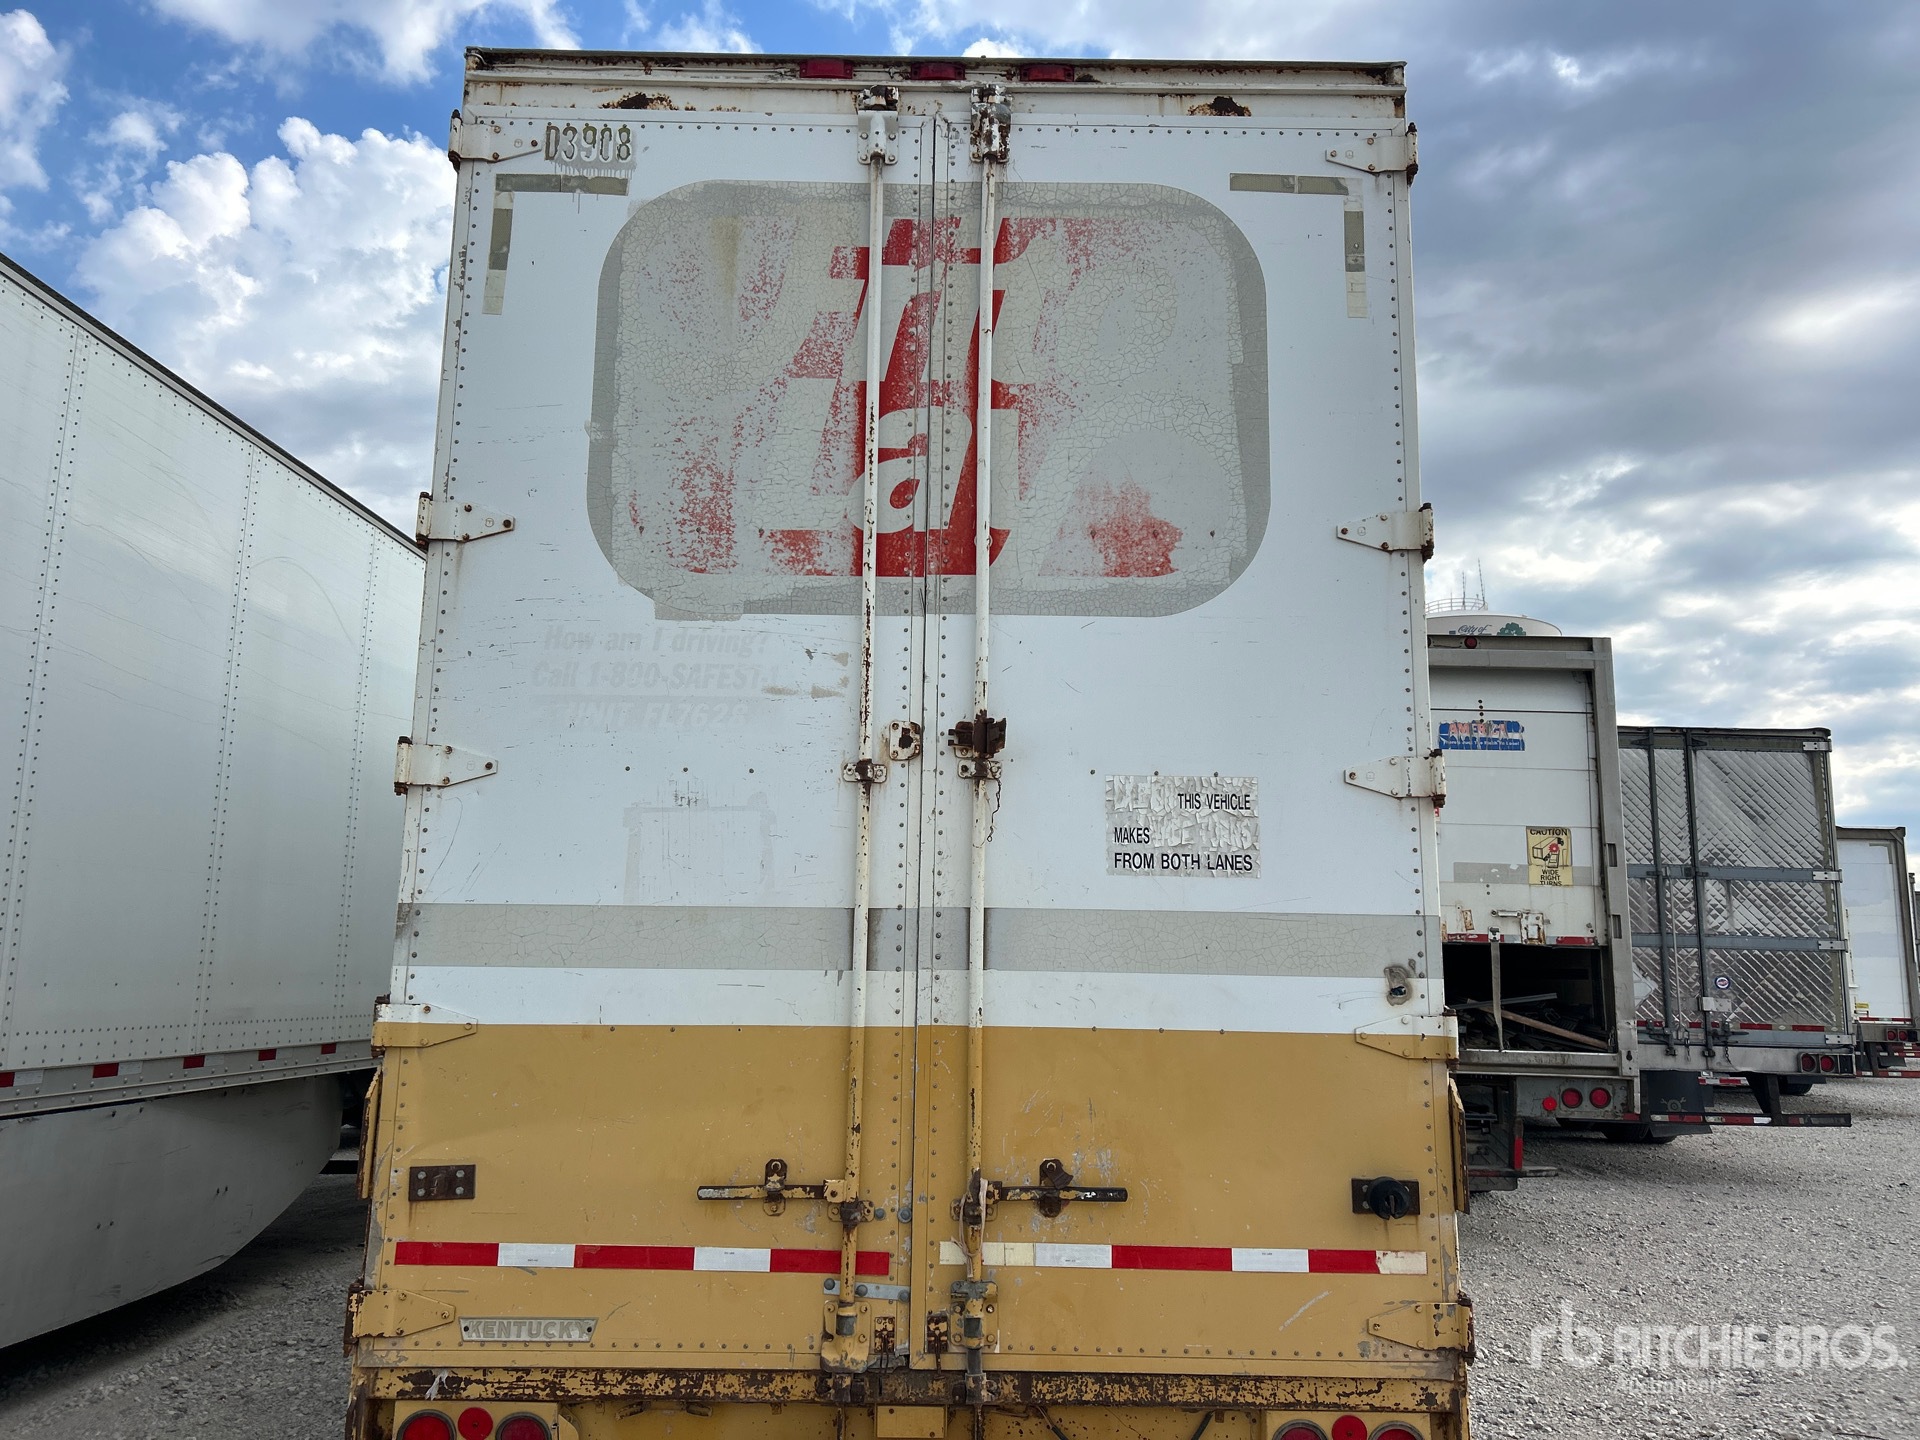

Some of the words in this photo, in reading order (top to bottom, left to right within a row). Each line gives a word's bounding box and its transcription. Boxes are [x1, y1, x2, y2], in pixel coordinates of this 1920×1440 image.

[545, 125, 632, 162] D3908
[1458, 625, 1477, 634] City
[1478, 625, 1492, 633] of
[1178, 793, 1201, 810] THIS
[1206, 793, 1251, 810] VEHICLE
[1114, 827, 1150, 844] MAKES
[1114, 853, 1154, 870] FROM
[1161, 853, 1200, 870] BOTH
[1207, 854, 1253, 871] LANES
[467, 1320, 589, 1339] KENTUCKY
